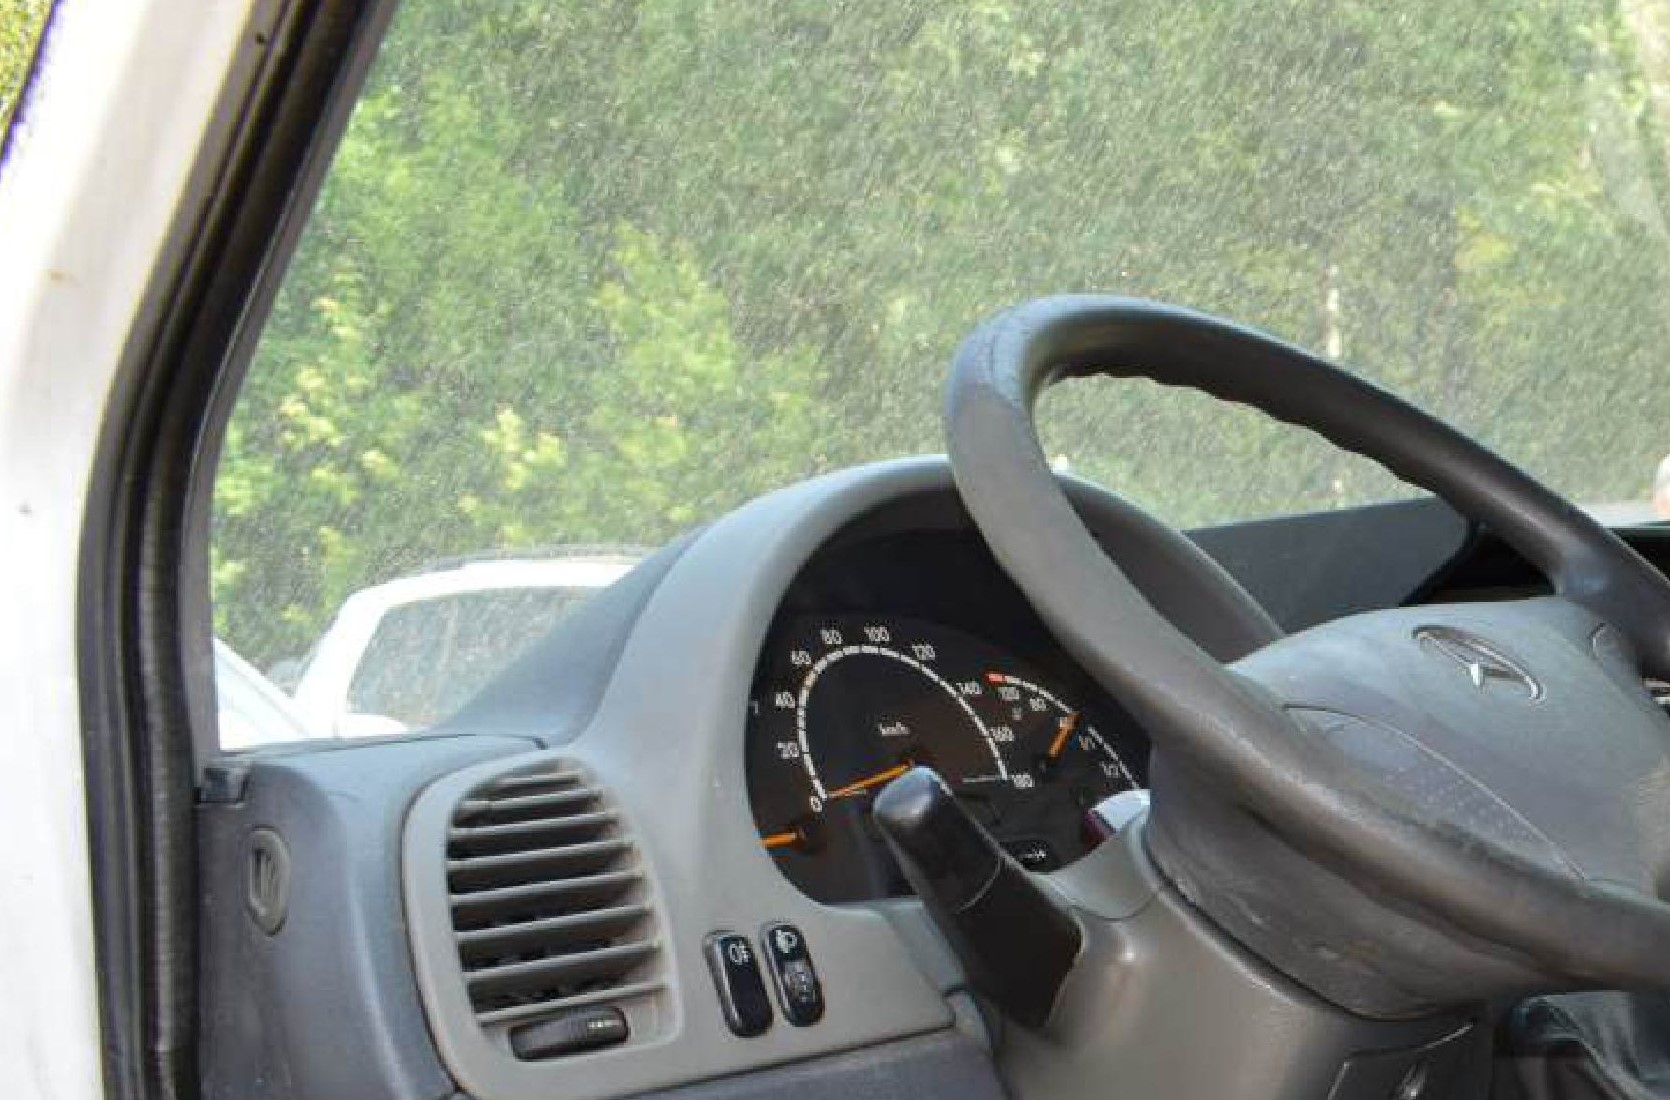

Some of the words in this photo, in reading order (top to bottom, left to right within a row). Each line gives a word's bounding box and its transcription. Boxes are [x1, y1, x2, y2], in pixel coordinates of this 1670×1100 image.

[820, 629, 842, 645] 80
[864, 626, 890, 642] 100
[810, 796, 822, 813] 0
